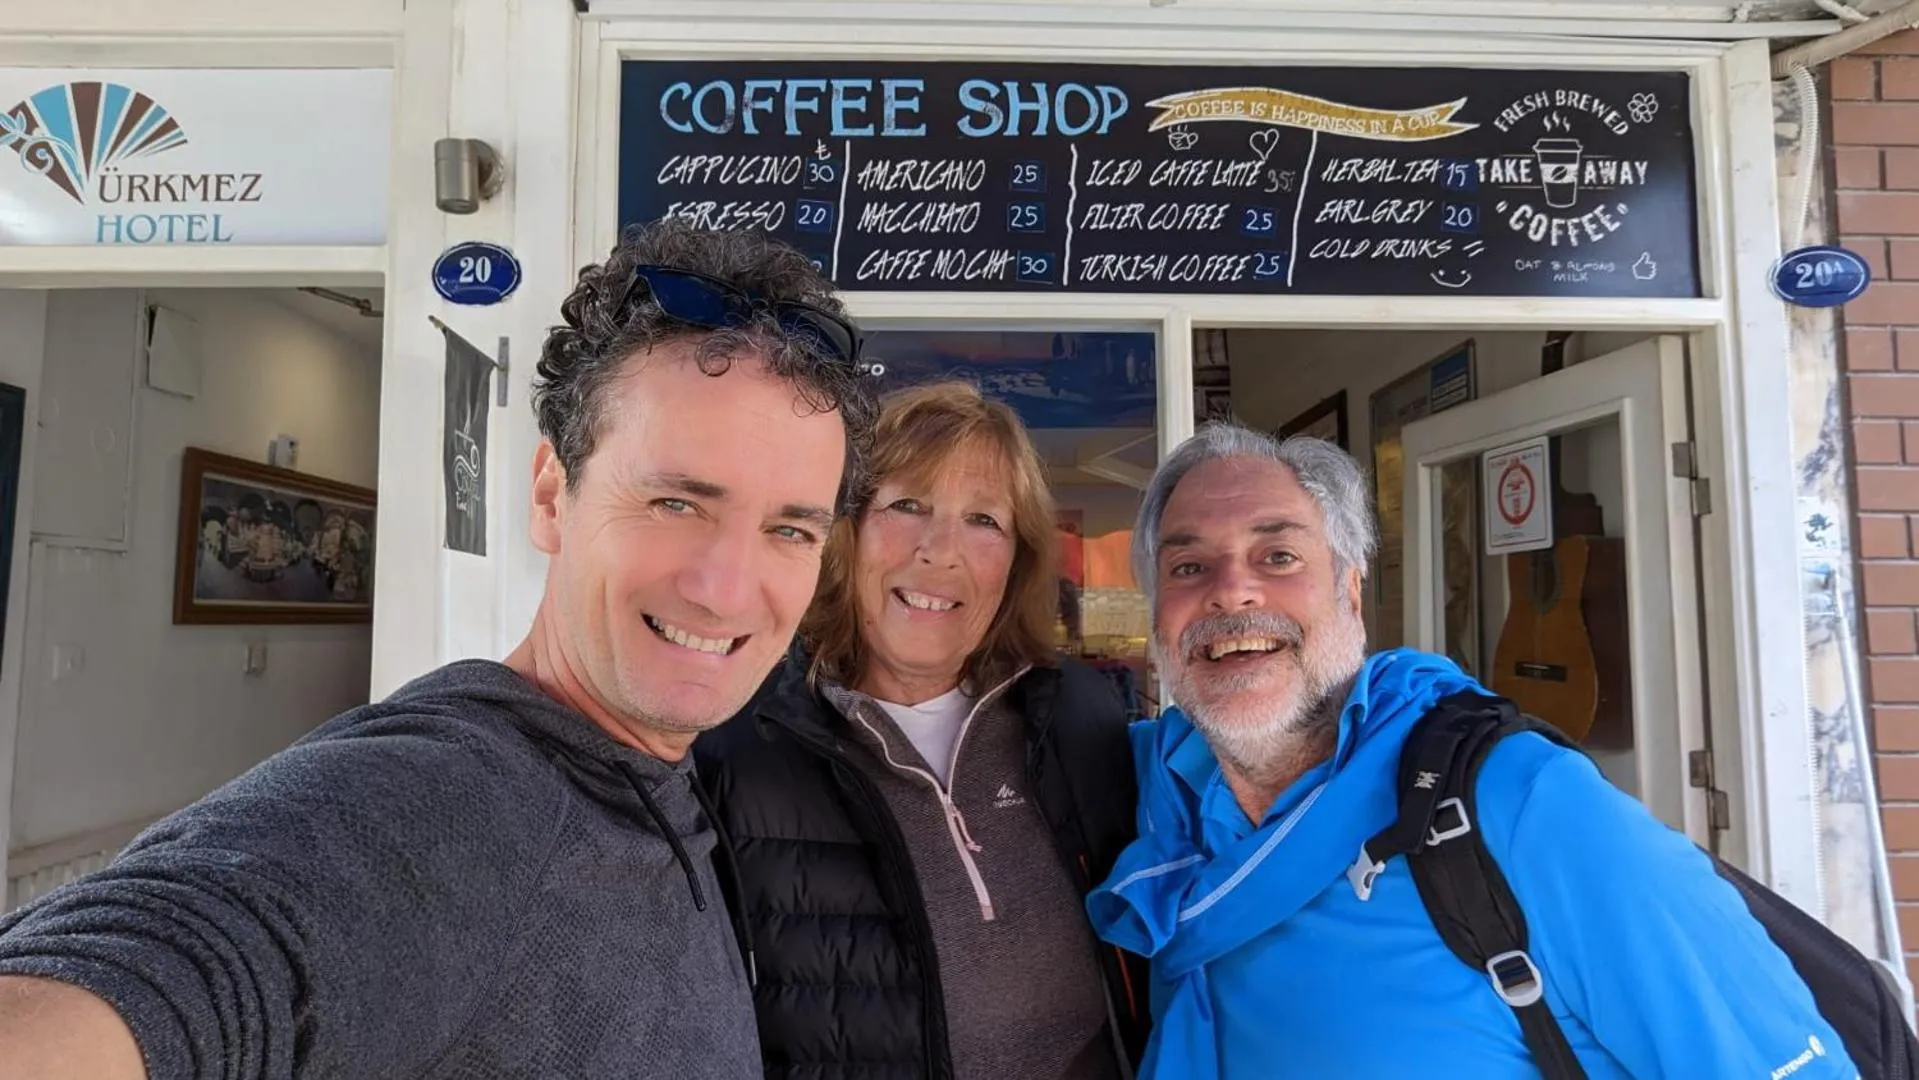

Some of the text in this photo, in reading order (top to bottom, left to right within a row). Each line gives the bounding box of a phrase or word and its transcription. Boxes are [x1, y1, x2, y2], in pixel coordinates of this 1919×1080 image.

[659, 79, 1128, 137] COFFEE SHOP
[1175, 100, 1440, 134] COFFEE IS HAPPINESS IN A CUP
[1493, 89, 1630, 136] FRESH BREWED
[657, 155, 835, 184] CAPPUCINO 30
[857, 159, 1038, 191] AMERICANO 25
[1086, 159, 1141, 186] ICED
[1149, 160, 1213, 187] CAFFE
[1211, 160, 1265, 187] LATTE
[1322, 158, 1469, 187] HERBAL TEA 15
[1475, 158, 1648, 185] TAKE AWAY
[98, 167, 262, 203] ÜRKMEZ
[661, 201, 826, 232] ESPRESSO 20
[857, 202, 1038, 234] MACCHIATO 25
[1080, 203, 1273, 230] FILTER COFFEE 25
[1315, 199, 1472, 227] EARL GREY 20
[97, 214, 234, 243] HOTEL
[1309, 238, 1453, 259] COLD DRINKS
[459, 256, 491, 283] 20
[856, 249, 932, 281] CAFFE
[931, 249, 1014, 280] MOCHA
[1021, 256, 1047, 274] 30
[1080, 253, 1280, 281] TURKISH COFFEE 25
[1514, 259, 1542, 271] OAT
[1553, 271, 1589, 282] MILK
